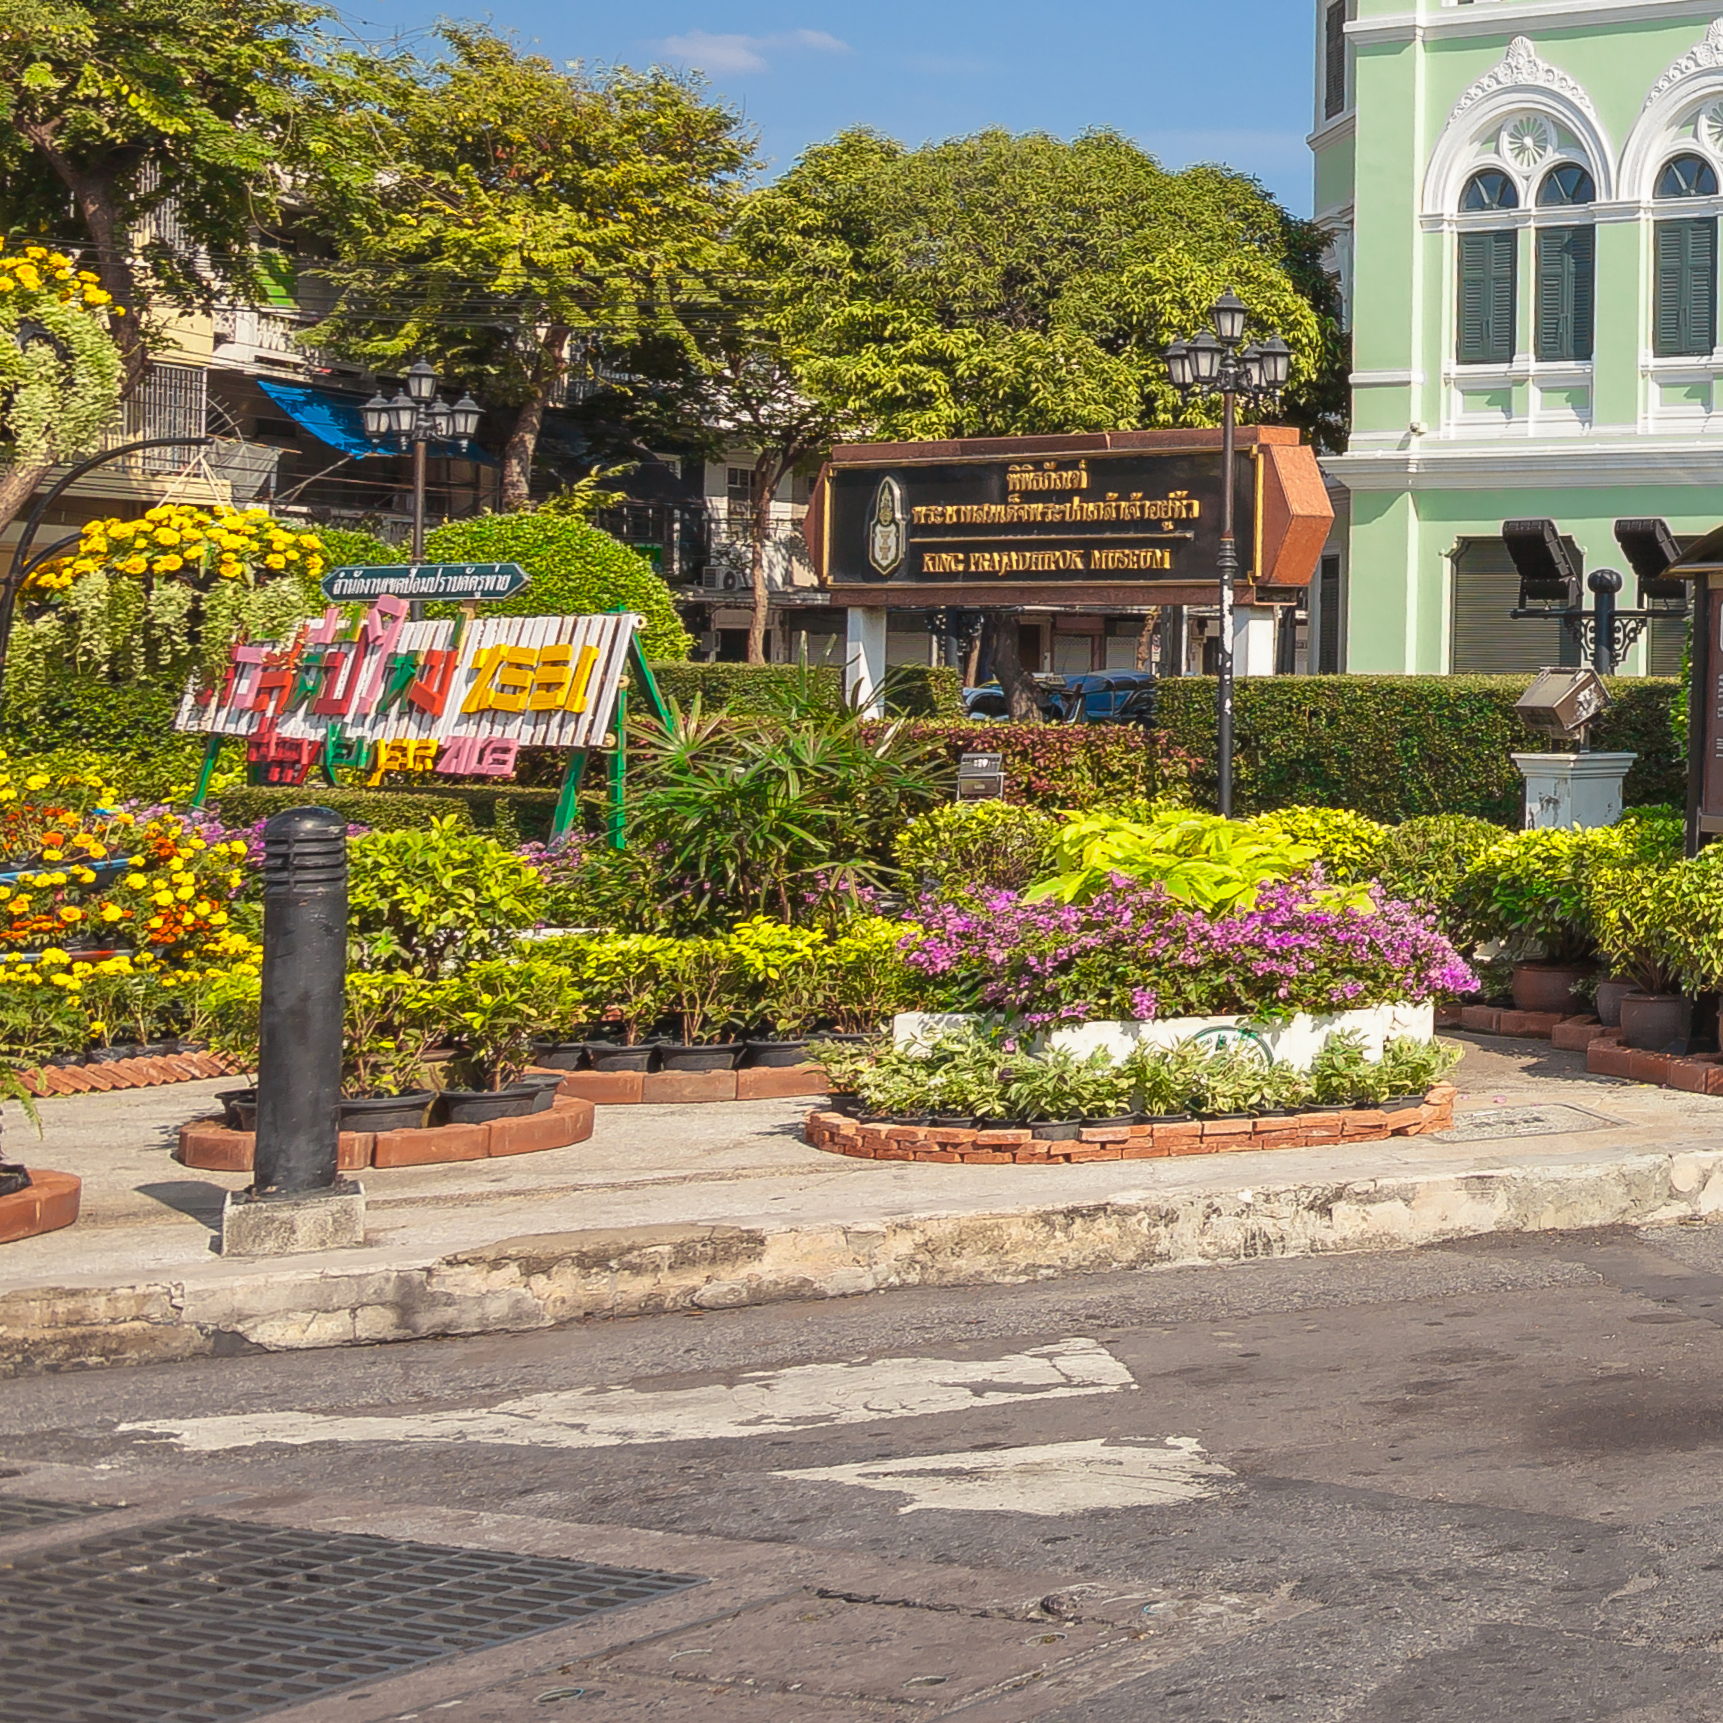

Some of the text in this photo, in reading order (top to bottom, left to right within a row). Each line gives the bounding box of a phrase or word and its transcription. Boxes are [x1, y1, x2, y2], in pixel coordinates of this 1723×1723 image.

[922, 548, 1172, 576] KING PRAJADHIPOK MUSEUM
